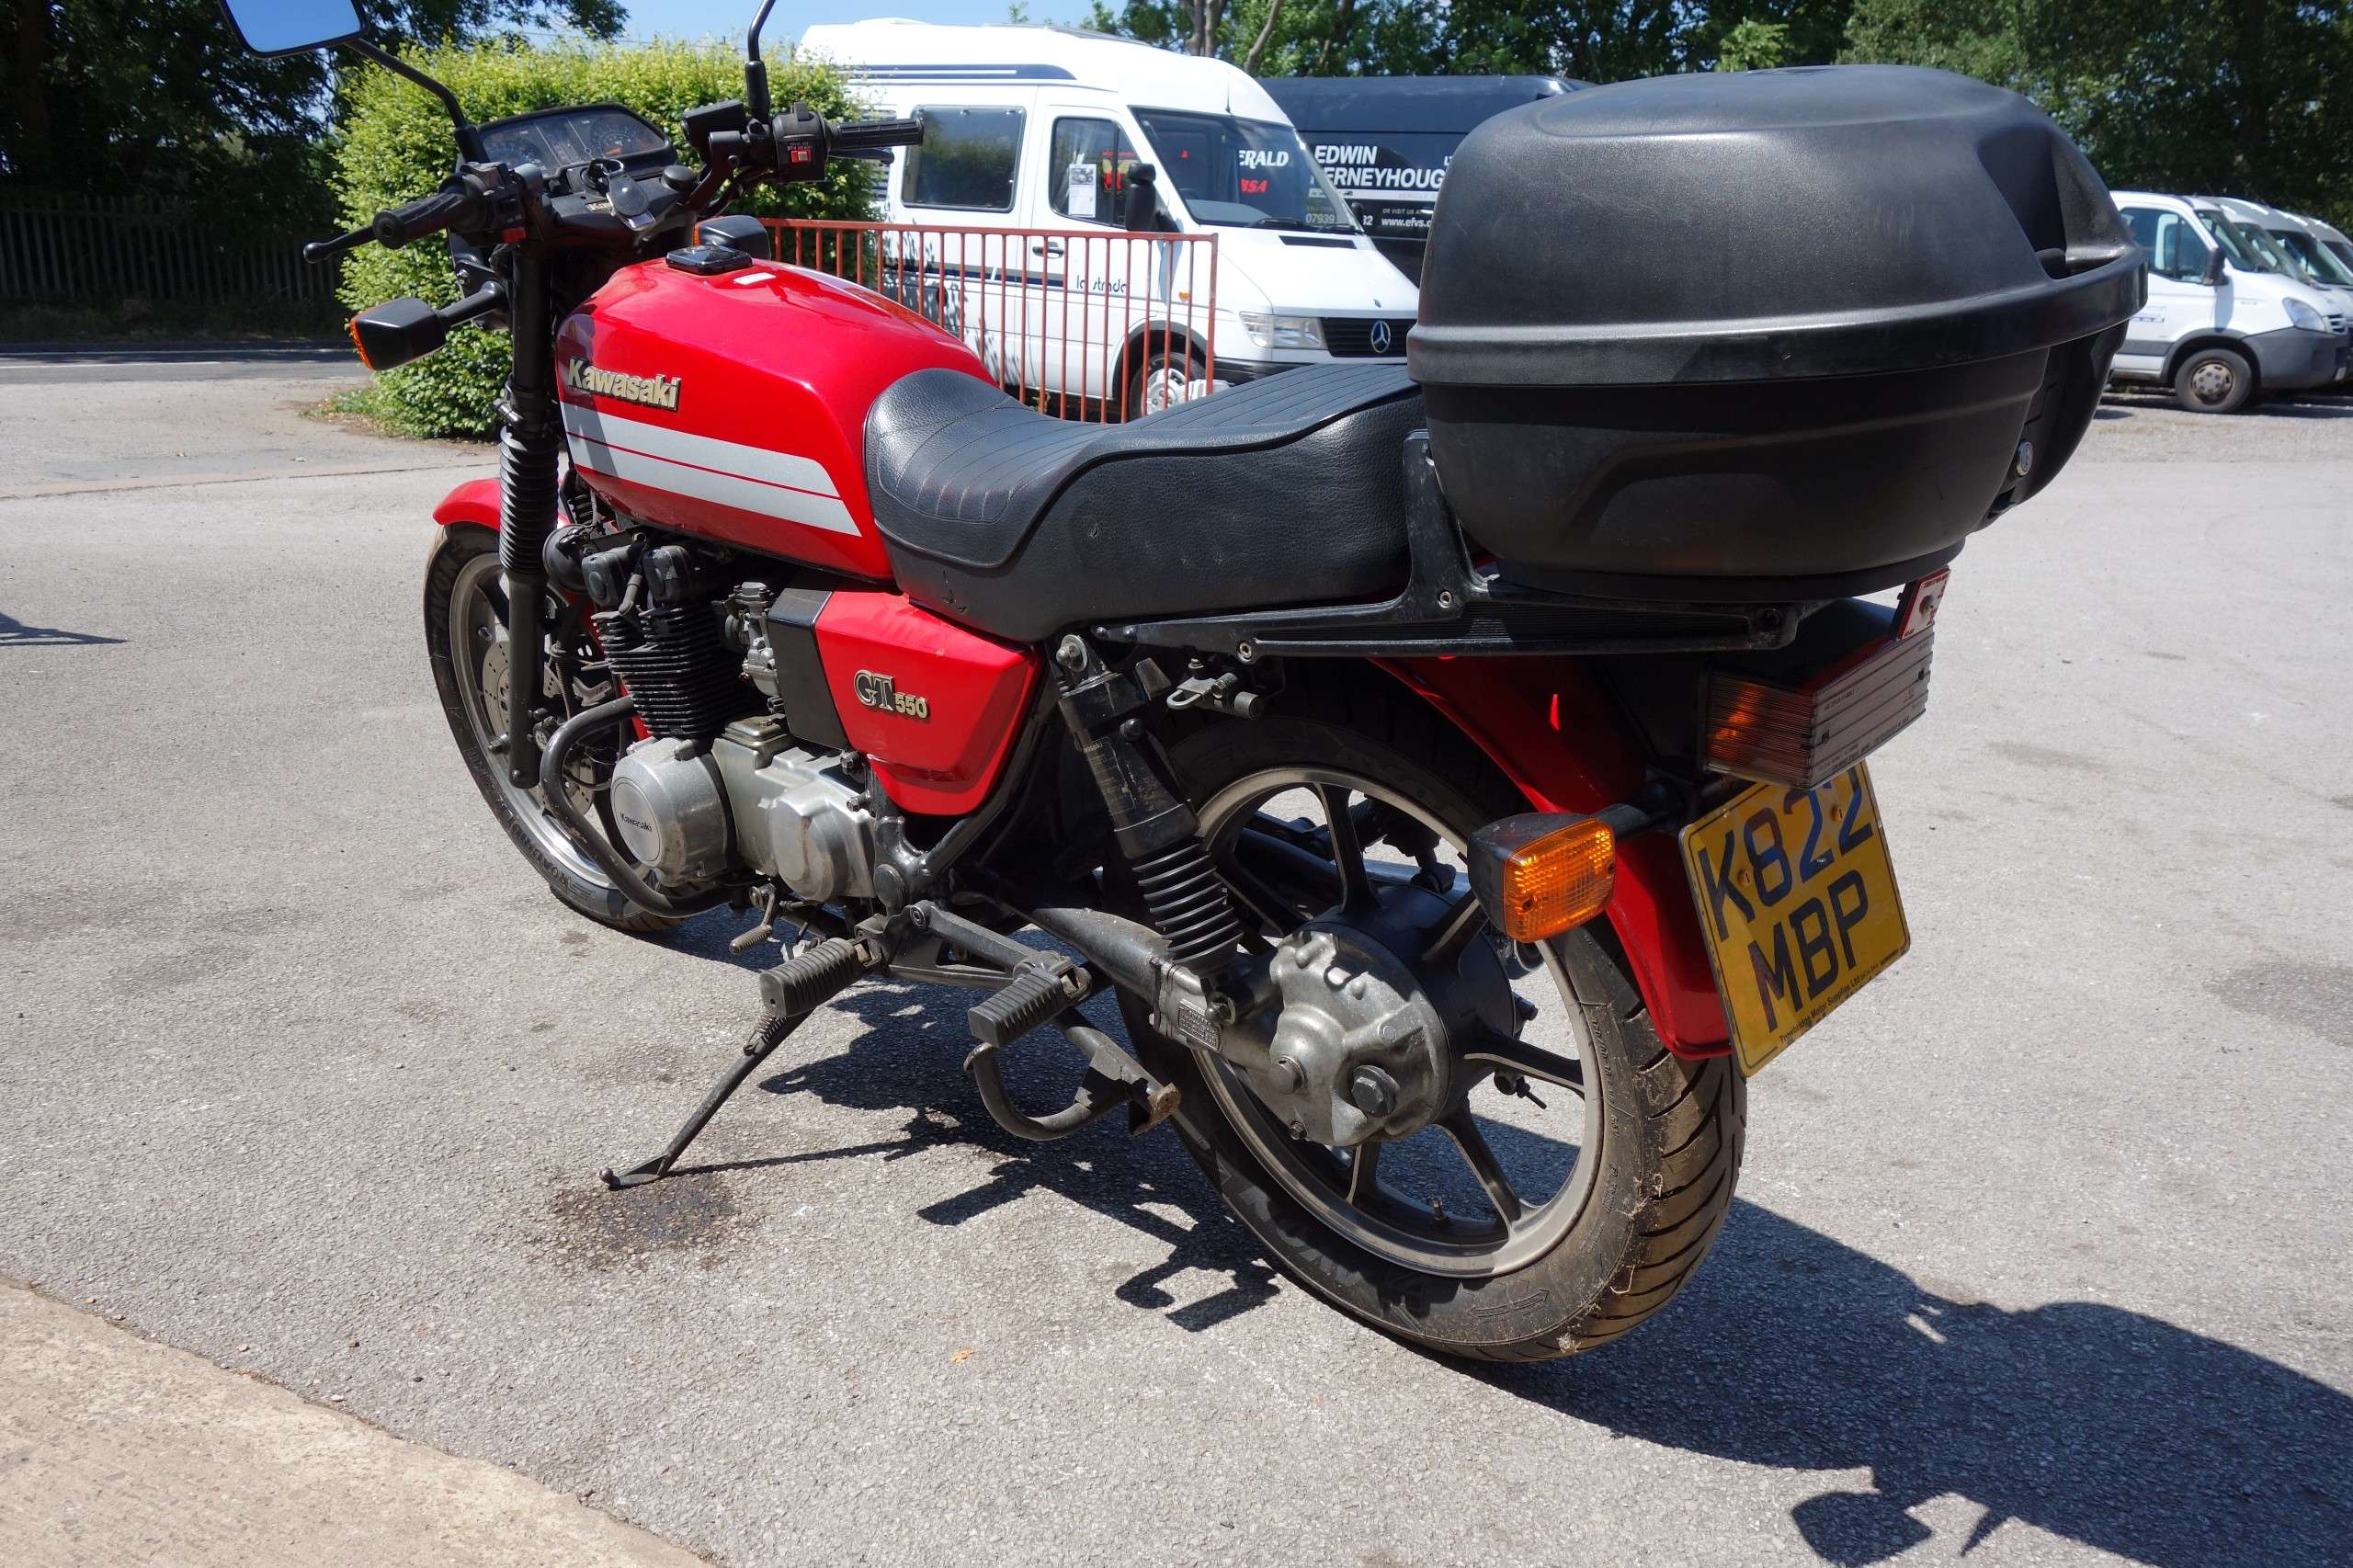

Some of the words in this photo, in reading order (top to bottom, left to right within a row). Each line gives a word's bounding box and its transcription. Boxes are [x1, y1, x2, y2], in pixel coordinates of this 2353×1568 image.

[1310, 167, 1447, 188] ERNEYHOUG
[1314, 145, 1378, 165] EDWIN
[568, 357, 681, 412] Kawasaki
[1698, 768, 1873, 943] K822
[1748, 869, 1869, 1033] MBP
